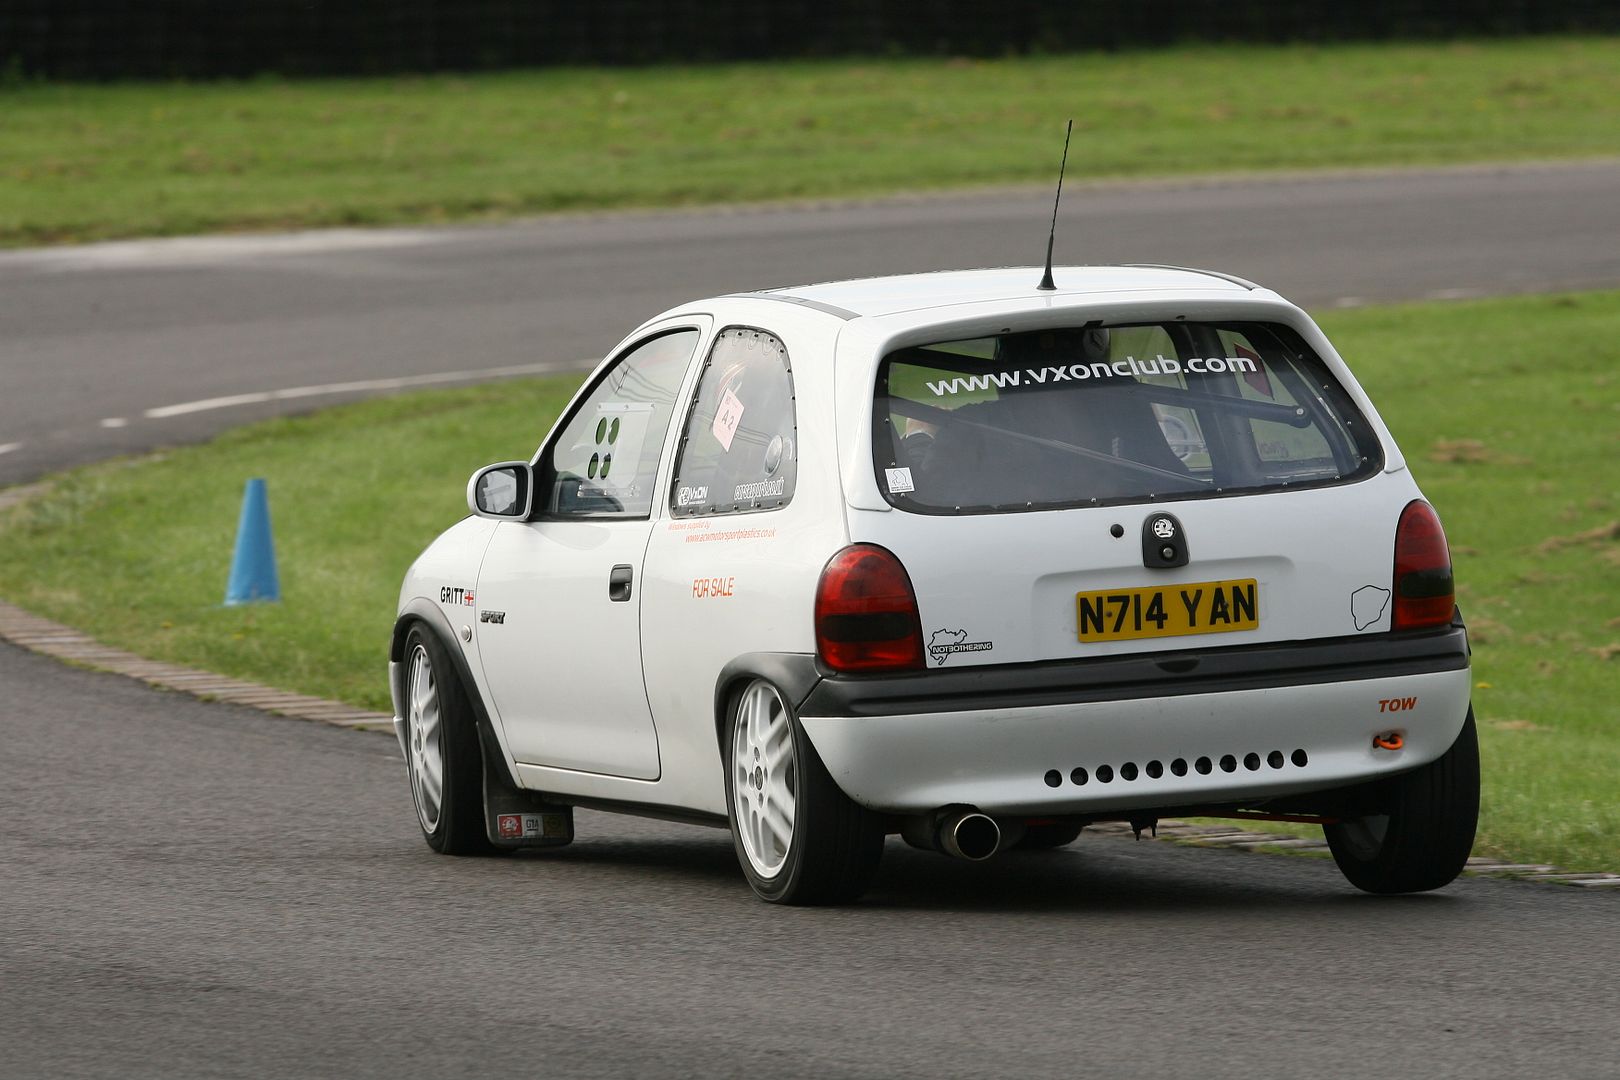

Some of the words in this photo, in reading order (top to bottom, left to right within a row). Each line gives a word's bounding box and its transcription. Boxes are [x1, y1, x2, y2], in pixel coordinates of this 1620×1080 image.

[926, 355, 1257, 396] www.vxonclub.com
[440, 586, 464, 604] GRITT
[692, 578, 709, 598] FOR
[711, 577, 734, 597] SALE
[480, 610, 505, 624] SPORT
[1080, 592, 1168, 634] N714
[1181, 584, 1256, 627] YAN
[932, 642, 992, 654] NOTBOTHERING
[1378, 696, 1417, 712] TOW
